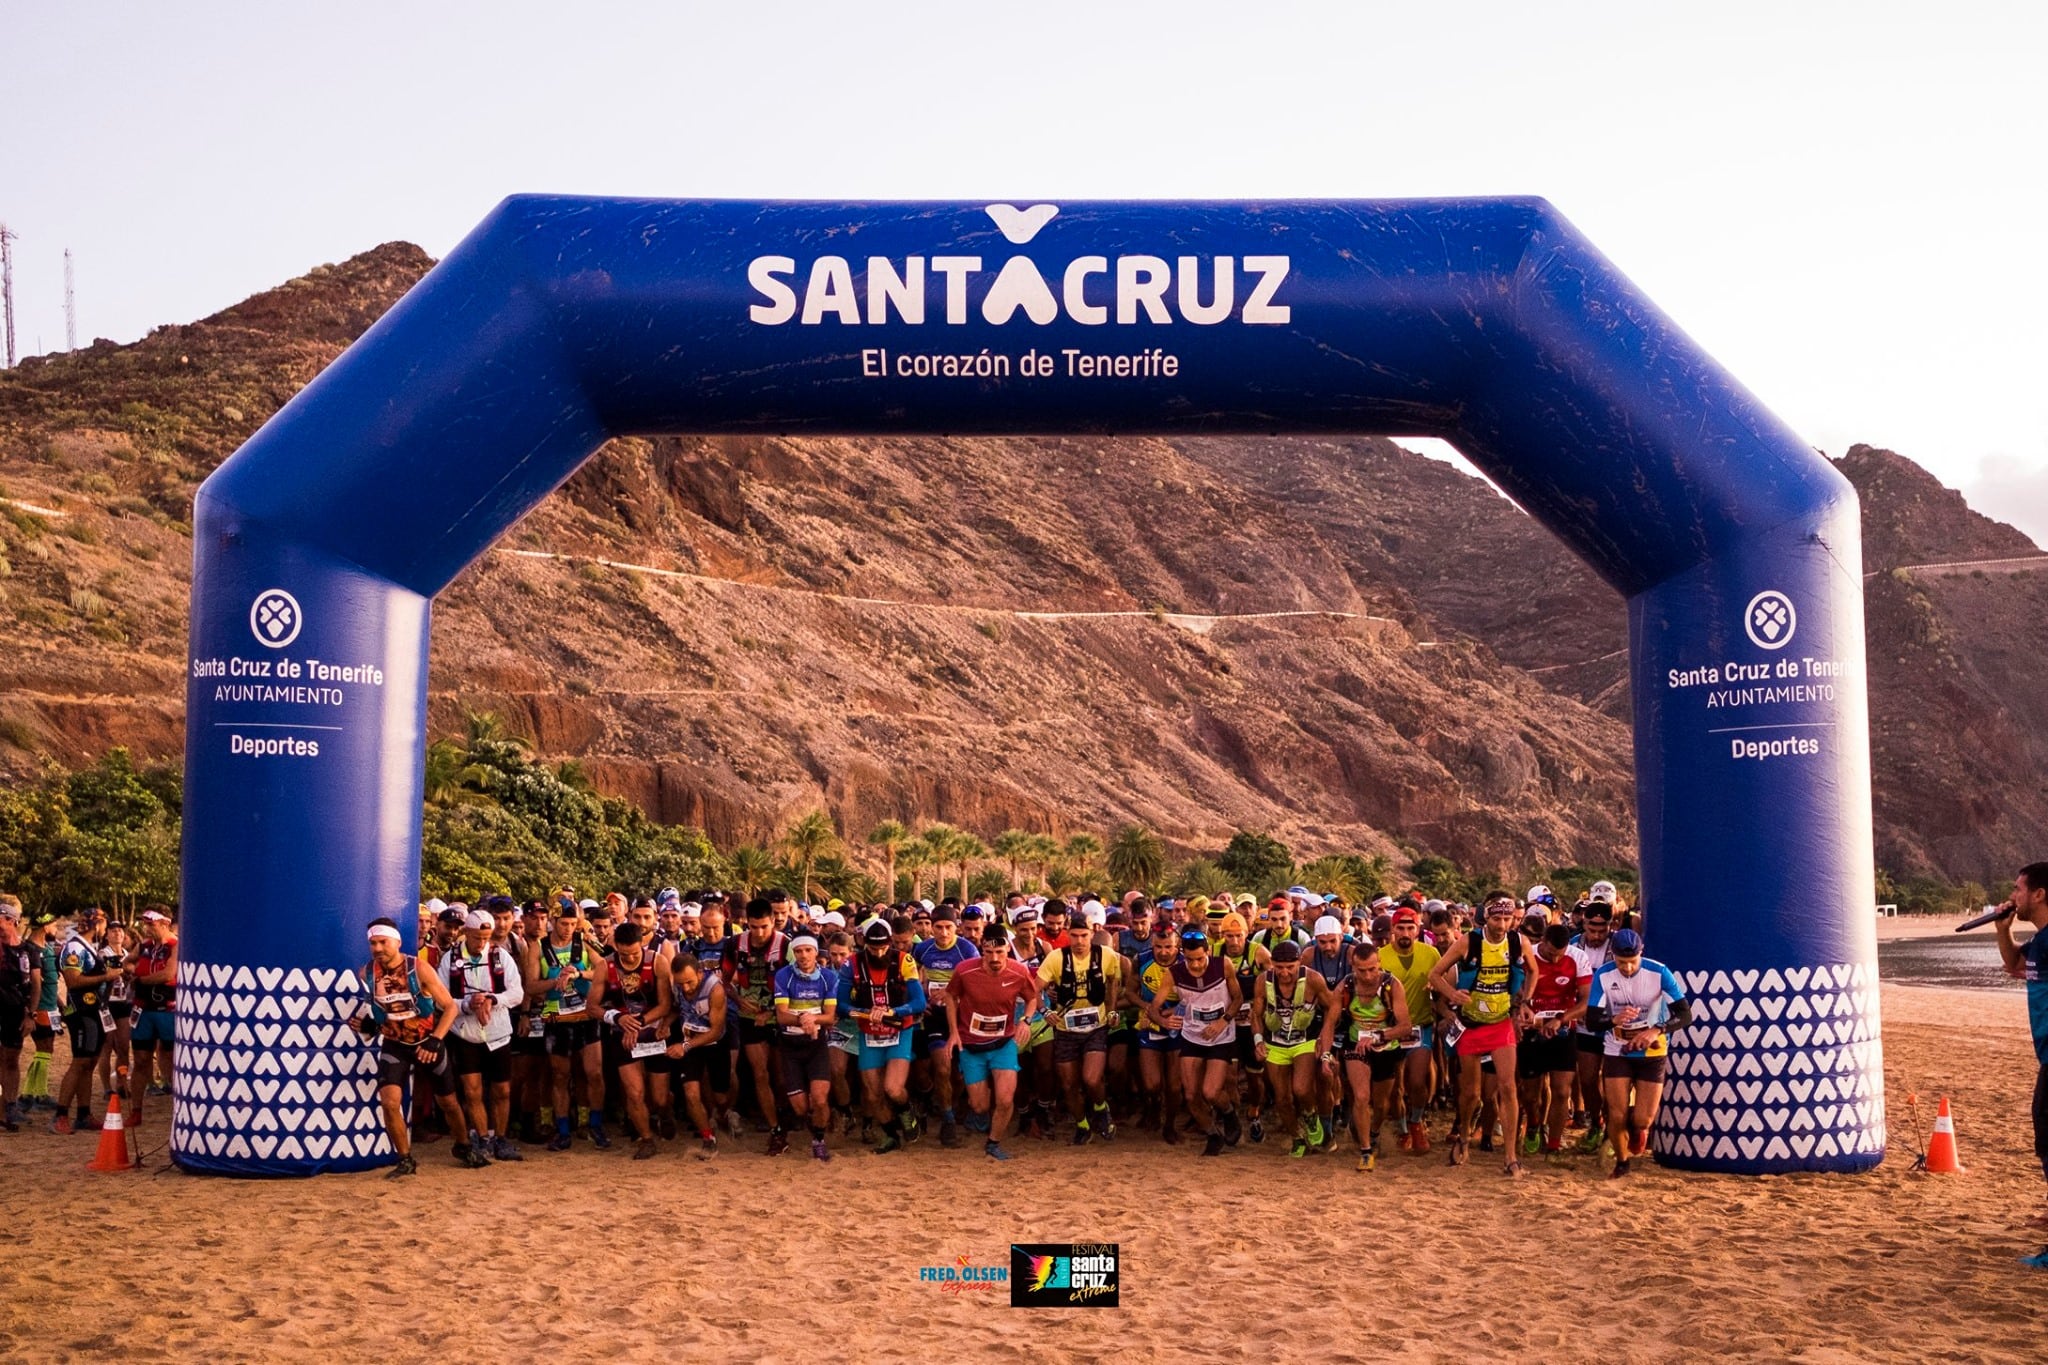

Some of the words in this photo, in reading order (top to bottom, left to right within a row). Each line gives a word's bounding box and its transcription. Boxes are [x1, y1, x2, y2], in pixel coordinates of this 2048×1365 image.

[862, 349, 886, 376] El
[896, 349, 1010, 376] corazón
[1020, 349, 1053, 376] de
[1062, 349, 1179, 376] Tenerife
[193, 658, 225, 678] Santa
[230, 657, 271, 677] Cruz
[276, 658, 301, 678] de
[307, 661, 383, 685] Tenerife
[1669, 665, 1719, 688] Santa
[1725, 662, 1770, 681] Cruz
[1776, 658, 1798, 678] de
[215, 685, 343, 706] AYUNTAMIENTO
[1707, 684, 1834, 708] AYUNTAMIENTO
[231, 734, 319, 758] Deportes
[1732, 736, 1819, 760] Deportes
